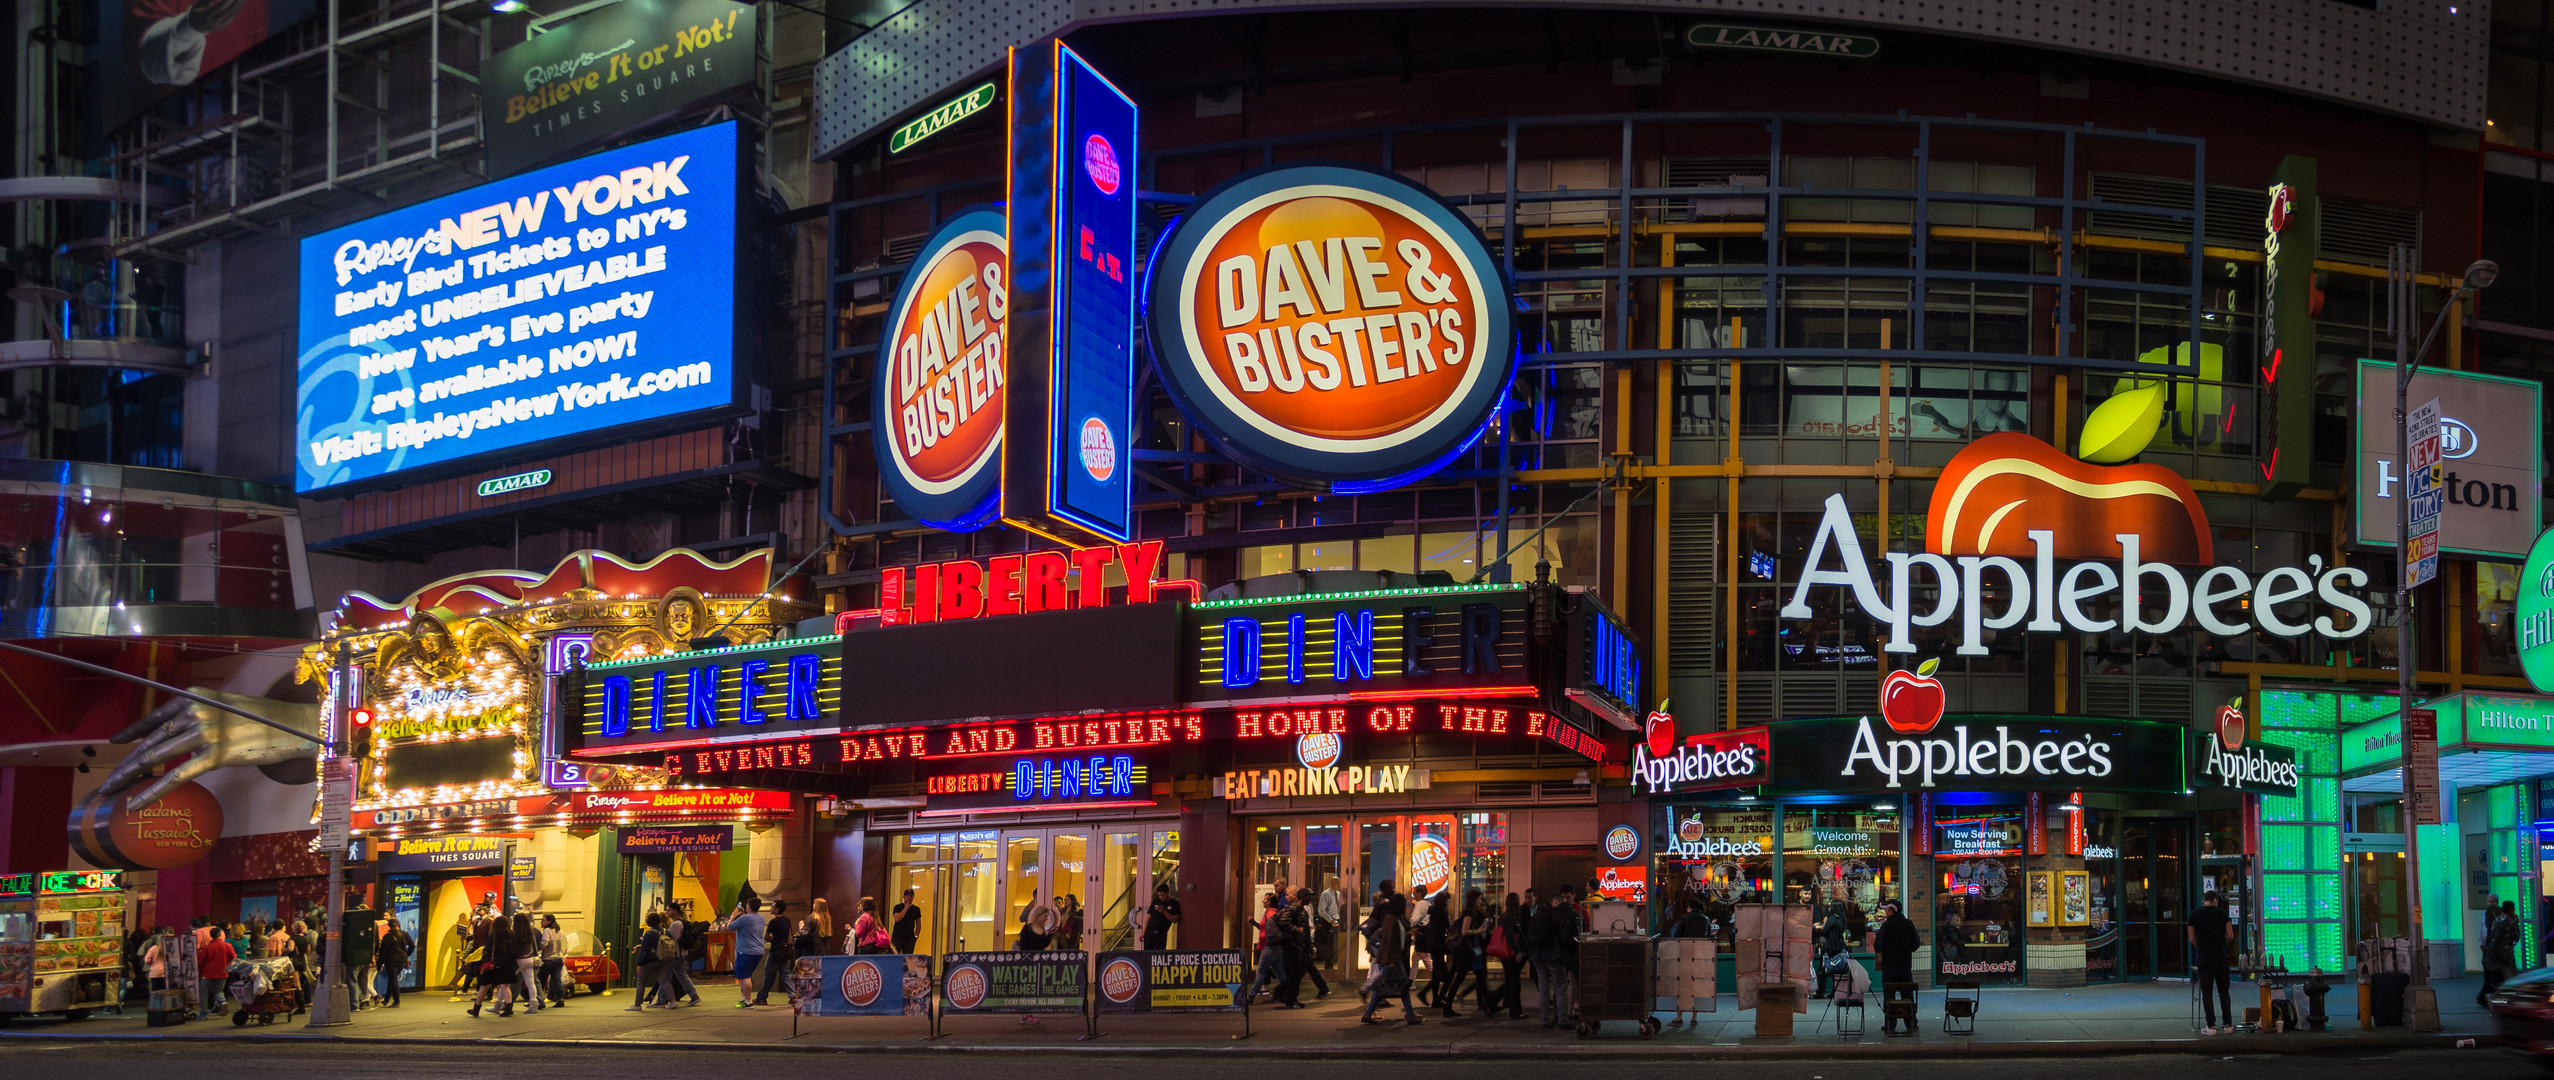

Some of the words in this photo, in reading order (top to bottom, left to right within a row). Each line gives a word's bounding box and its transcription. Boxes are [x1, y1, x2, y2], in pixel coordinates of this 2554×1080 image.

[1715, 29, 1853, 52] LAMAR
[505, 71, 600, 123] Believe
[606, 53, 632, 84] It
[638, 44, 669, 71] or
[674, 10, 737, 59] Not!
[533, 101, 601, 137] TIMES
[620, 58, 713, 103] SQUARE
[903, 90, 981, 145] LAMAR
[439, 191, 550, 256] NEW
[553, 155, 690, 224] YORK
[335, 280, 402, 317] Early
[407, 259, 464, 298] Bird
[468, 232, 572, 280] Tickets
[576, 223, 609, 252] to
[615, 207, 688, 243] NY's
[1217, 236, 1402, 329] DAVE
[1397, 238, 1458, 304] &
[349, 309, 417, 347] most
[420, 245, 667, 327] UNBELIEVEABLE
[359, 347, 417, 379] New
[421, 324, 506, 363] Year's
[510, 313, 565, 343] Eve
[569, 290, 654, 329] party
[901, 274, 986, 405] DAVE
[982, 262, 1007, 321] &
[1225, 307, 1465, 393] BUSTER'S
[371, 385, 416, 415] are
[418, 354, 544, 404] available
[548, 331, 638, 374] NOW!
[310, 429, 383, 467] Visit:
[386, 361, 712, 449] RipleysNewYork.com
[2413, 410, 2421, 420] THE
[2421, 405, 2431, 415] NEW
[2420, 413, 2436, 428] STREET
[1081, 426, 1105, 448] DAVE
[2409, 438, 2437, 470] NEW
[483, 472, 544, 494] LAMAR
[2377, 460, 2519, 511] Hton
[2409, 470, 2430, 495] VIC
[2411, 489, 2441, 521] TORY
[2408, 517, 2436, 536] THEATER
[2408, 538, 2421, 563] 20
[880, 540, 1164, 628] LIBERTY
[1780, 493, 2373, 655] Applebee's
[1222, 603, 1500, 688] DINER
[1595, 612, 1640, 716] DINER
[602, 654, 821, 738] DINER
[379, 716, 436, 740] Believe
[456, 714, 476, 731] or
[2480, 711, 2538, 730] Hilton
[666, 755, 682, 776] G
[697, 744, 811, 774] EVENTS
[840, 735, 926, 762] DAVE
[946, 726, 1015, 755] AND
[1034, 715, 1201, 750] BUSTER'S
[1237, 709, 1346, 738] HOME
[1370, 706, 1414, 732] OF
[1440, 705, 1507, 733] THE
[1302, 734, 1328, 751] DAVE
[1327, 733, 1336, 745] &
[1841, 716, 2111, 788] Applebee's
[2365, 737, 2383, 752] Hilton
[1303, 745, 1337, 763] BUSTER'S
[2206, 733, 2298, 788] Applebee's
[928, 773, 1003, 795] LIBERTY
[1015, 756, 1132, 799] DINER
[1631, 742, 1754, 793] Applebee's
[1224, 770, 1260, 799] EAT
[1268, 766, 1339, 798] DRINK
[1348, 765, 1410, 795] PLAY
[653, 794, 698, 806] Believe
[699, 793, 711, 805] It
[713, 795, 726, 805] or
[727, 792, 755, 805] Not!
[374, 800, 513, 825] ODDITORIUM
[127, 819, 202, 848] Tussauds
[626, 836, 667, 846] Believe
[669, 834, 681, 845] It
[682, 836, 695, 845] or
[696, 833, 721, 844] Not!
[1610, 833, 1628, 845] DAVE
[1628, 833, 1634, 842] &
[1948, 830, 1969, 838] Now
[1971, 830, 2008, 841] Serving
[1955, 840, 2000, 849] Breakfast
[398, 839, 441, 855] Believe
[443, 837, 455, 852] It
[457, 839, 470, 851] or
[472, 837, 499, 850] Not!
[431, 854, 458, 862] TIMES
[462, 851, 500, 861] SQUARE
[1610, 842, 1635, 853] BUSTER'S
[1667, 834, 1761, 859] Applebee's
[1412, 848, 1436, 870] AVE
[1433, 847, 1446, 861] &
[42, 874, 69, 891] ICE
[1412, 861, 1448, 887] USTER'S
[1600, 878, 1644, 891] Applebee's
[1683, 876, 1747, 893] Applebee's
[2205, 879, 2213, 888] A
[1151, 955, 1172, 966] HALF
[1173, 954, 1200, 966] PRICE
[1201, 953, 1242, 965] COCKTAIL
[1943, 960, 2016, 975] Applebee's
[846, 969, 869, 986] DAVE
[869, 968, 877, 980] &
[952, 976, 973, 991] DAVE
[974, 974, 982, 984] &
[992, 966, 1037, 983] WATCH
[1042, 965, 1079, 985] PLAY
[1106, 968, 1127, 984] DAVE
[1128, 968, 1135, 978] &
[1151, 965, 1198, 984] HAPPY
[1203, 965, 1242, 983] HOUR
[847, 980, 879, 998] BUSTER'S
[952, 985, 983, 1001] BUSTER'S
[992, 984, 1007, 995] THE
[1008, 984, 1036, 995] GAMES
[1042, 985, 1055, 994] THE
[1056, 985, 1079, 995] GAMES
[1107, 979, 1138, 995] BUSTER'S
